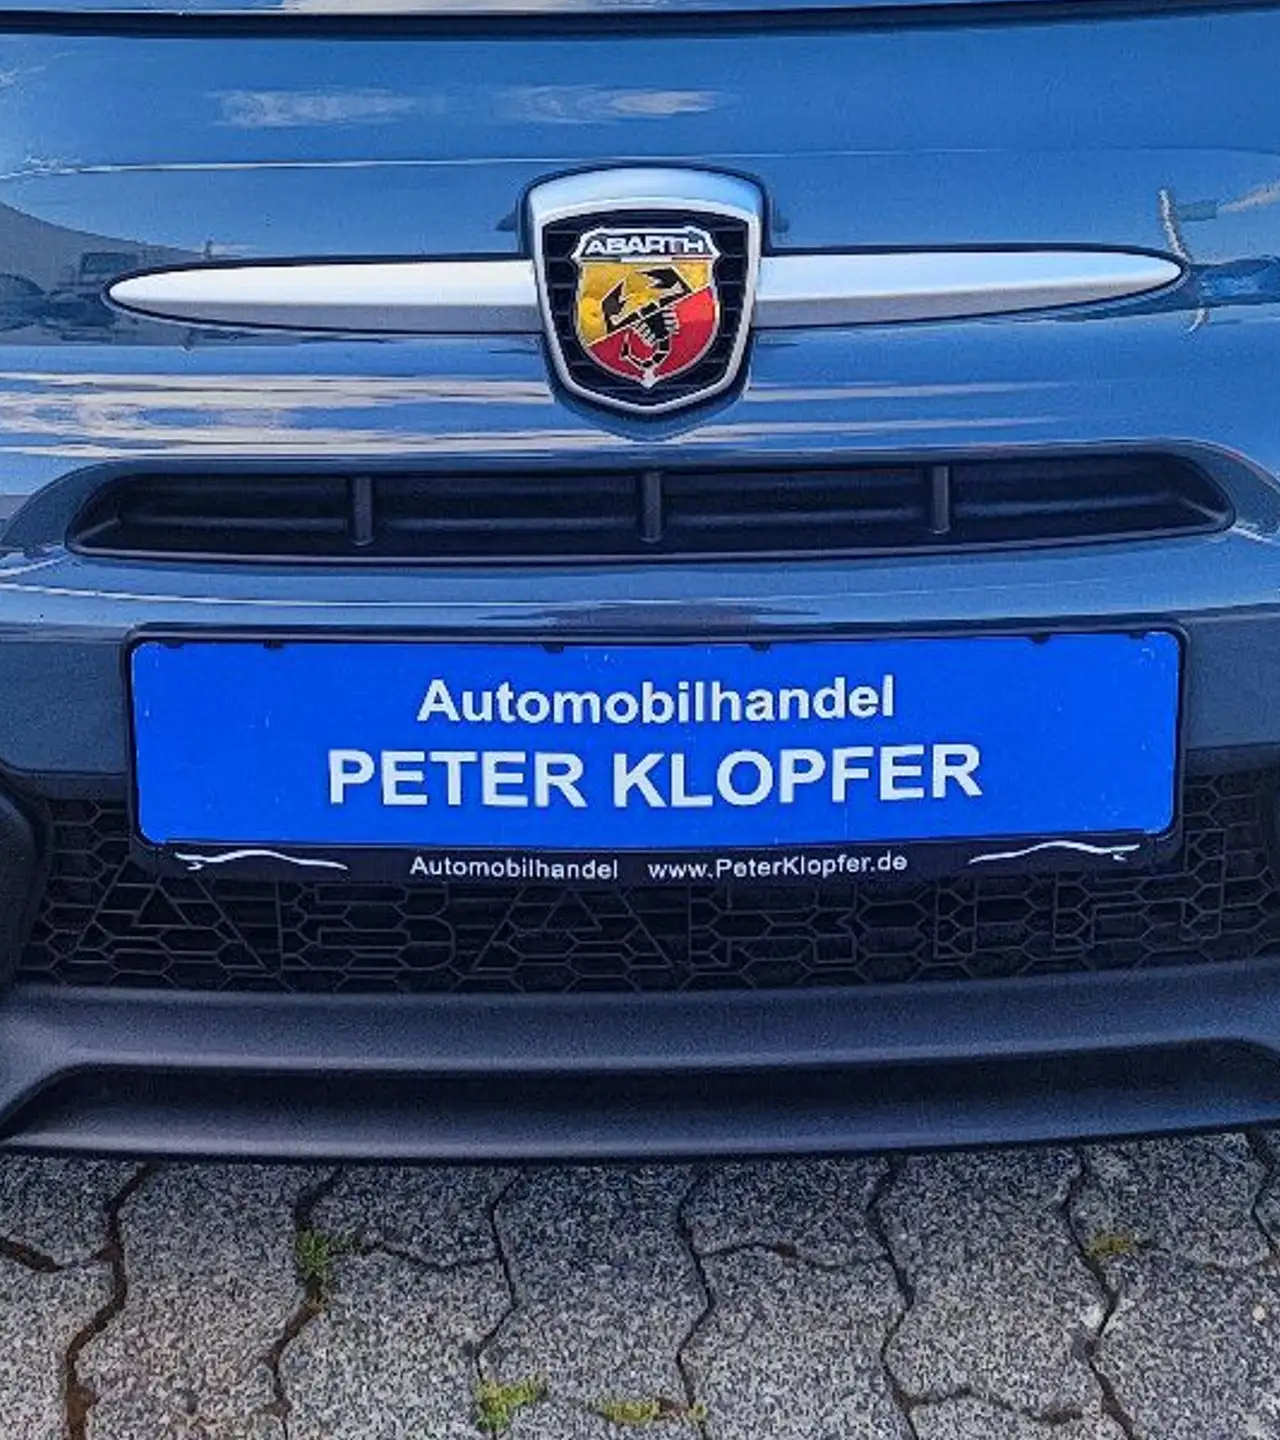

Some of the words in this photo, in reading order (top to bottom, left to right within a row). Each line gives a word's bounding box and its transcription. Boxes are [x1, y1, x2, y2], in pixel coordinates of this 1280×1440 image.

[585, 235, 704, 255] ABARTH
[417, 674, 895, 724] Automobilhandel
[328, 749, 588, 808] PETER
[614, 743, 983, 807] KLOPFER
[410, 856, 619, 880] Automobilhandel
[648, 852, 908, 880] www.PeterKlopfer.de
